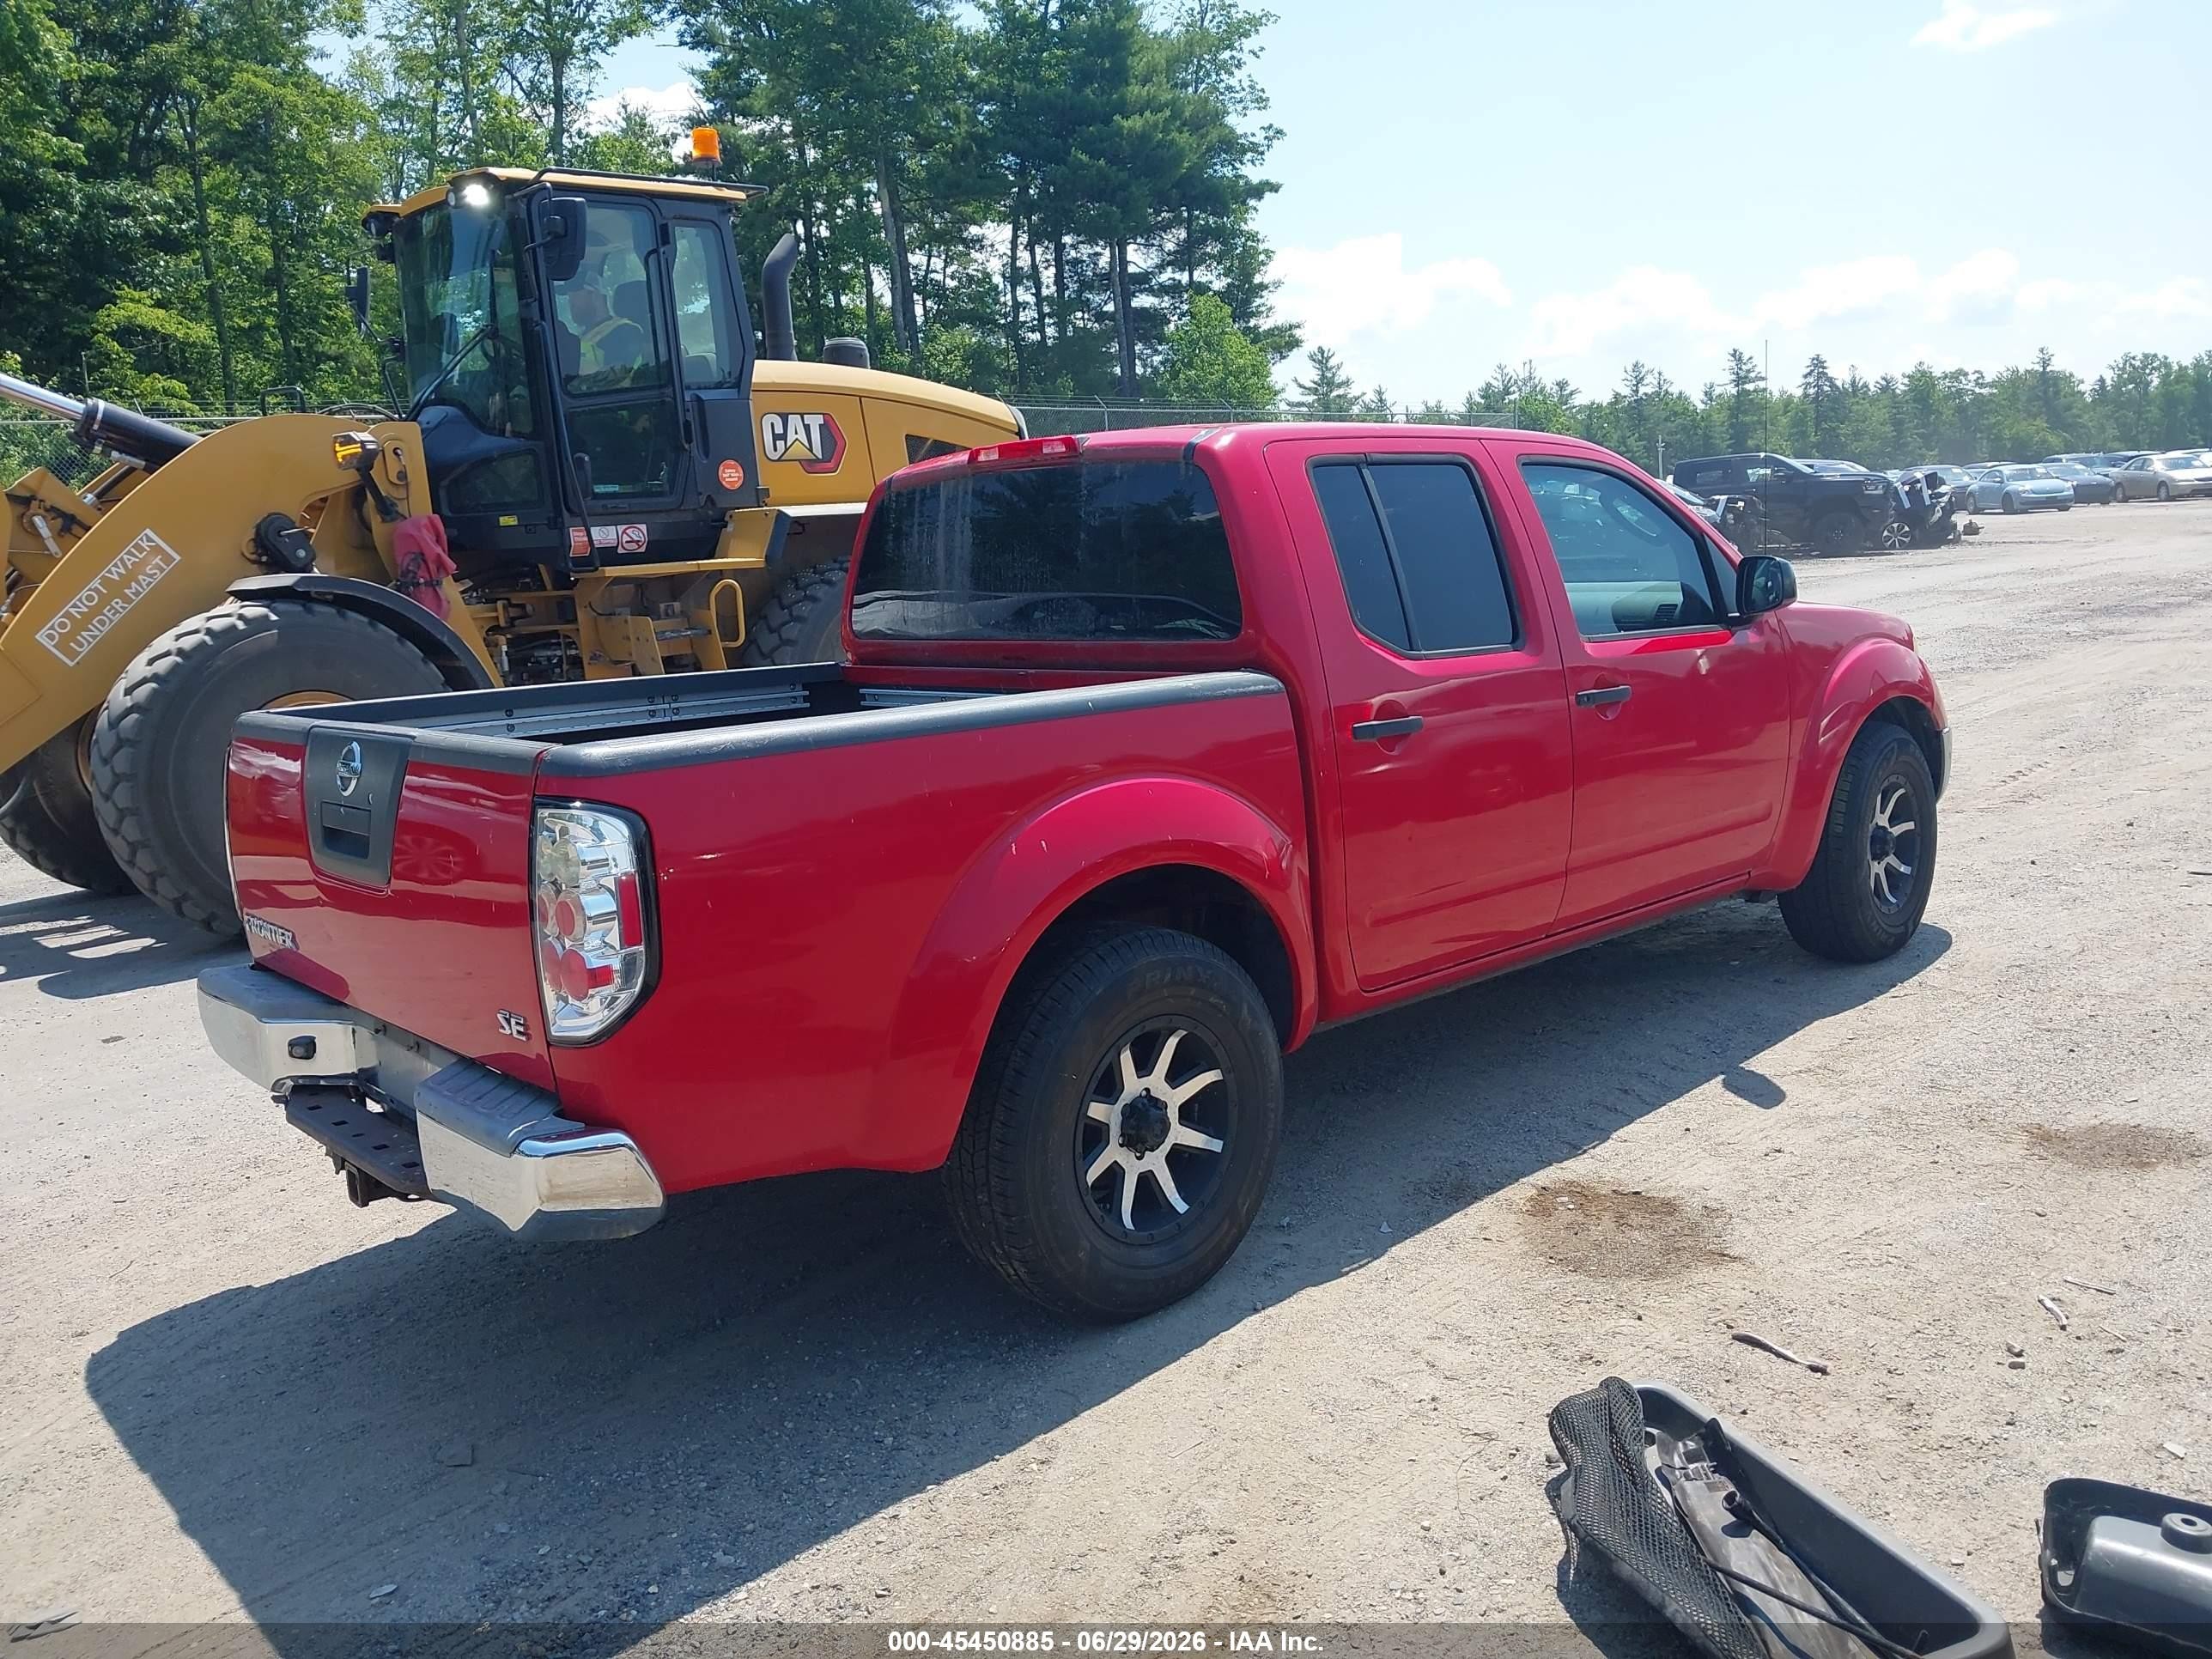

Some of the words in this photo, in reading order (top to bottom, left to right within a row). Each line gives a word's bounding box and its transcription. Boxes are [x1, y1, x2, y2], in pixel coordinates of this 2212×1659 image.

[762, 413, 824, 460] CAT
[42, 617, 71, 646] DO
[68, 579, 108, 619] NOT
[104, 534, 157, 581] WALK
[69, 598, 130, 652] UNDER
[123, 555, 168, 600] MAST
[244, 915, 293, 949] FRONTIER
[496, 1009, 527, 1042] SE
